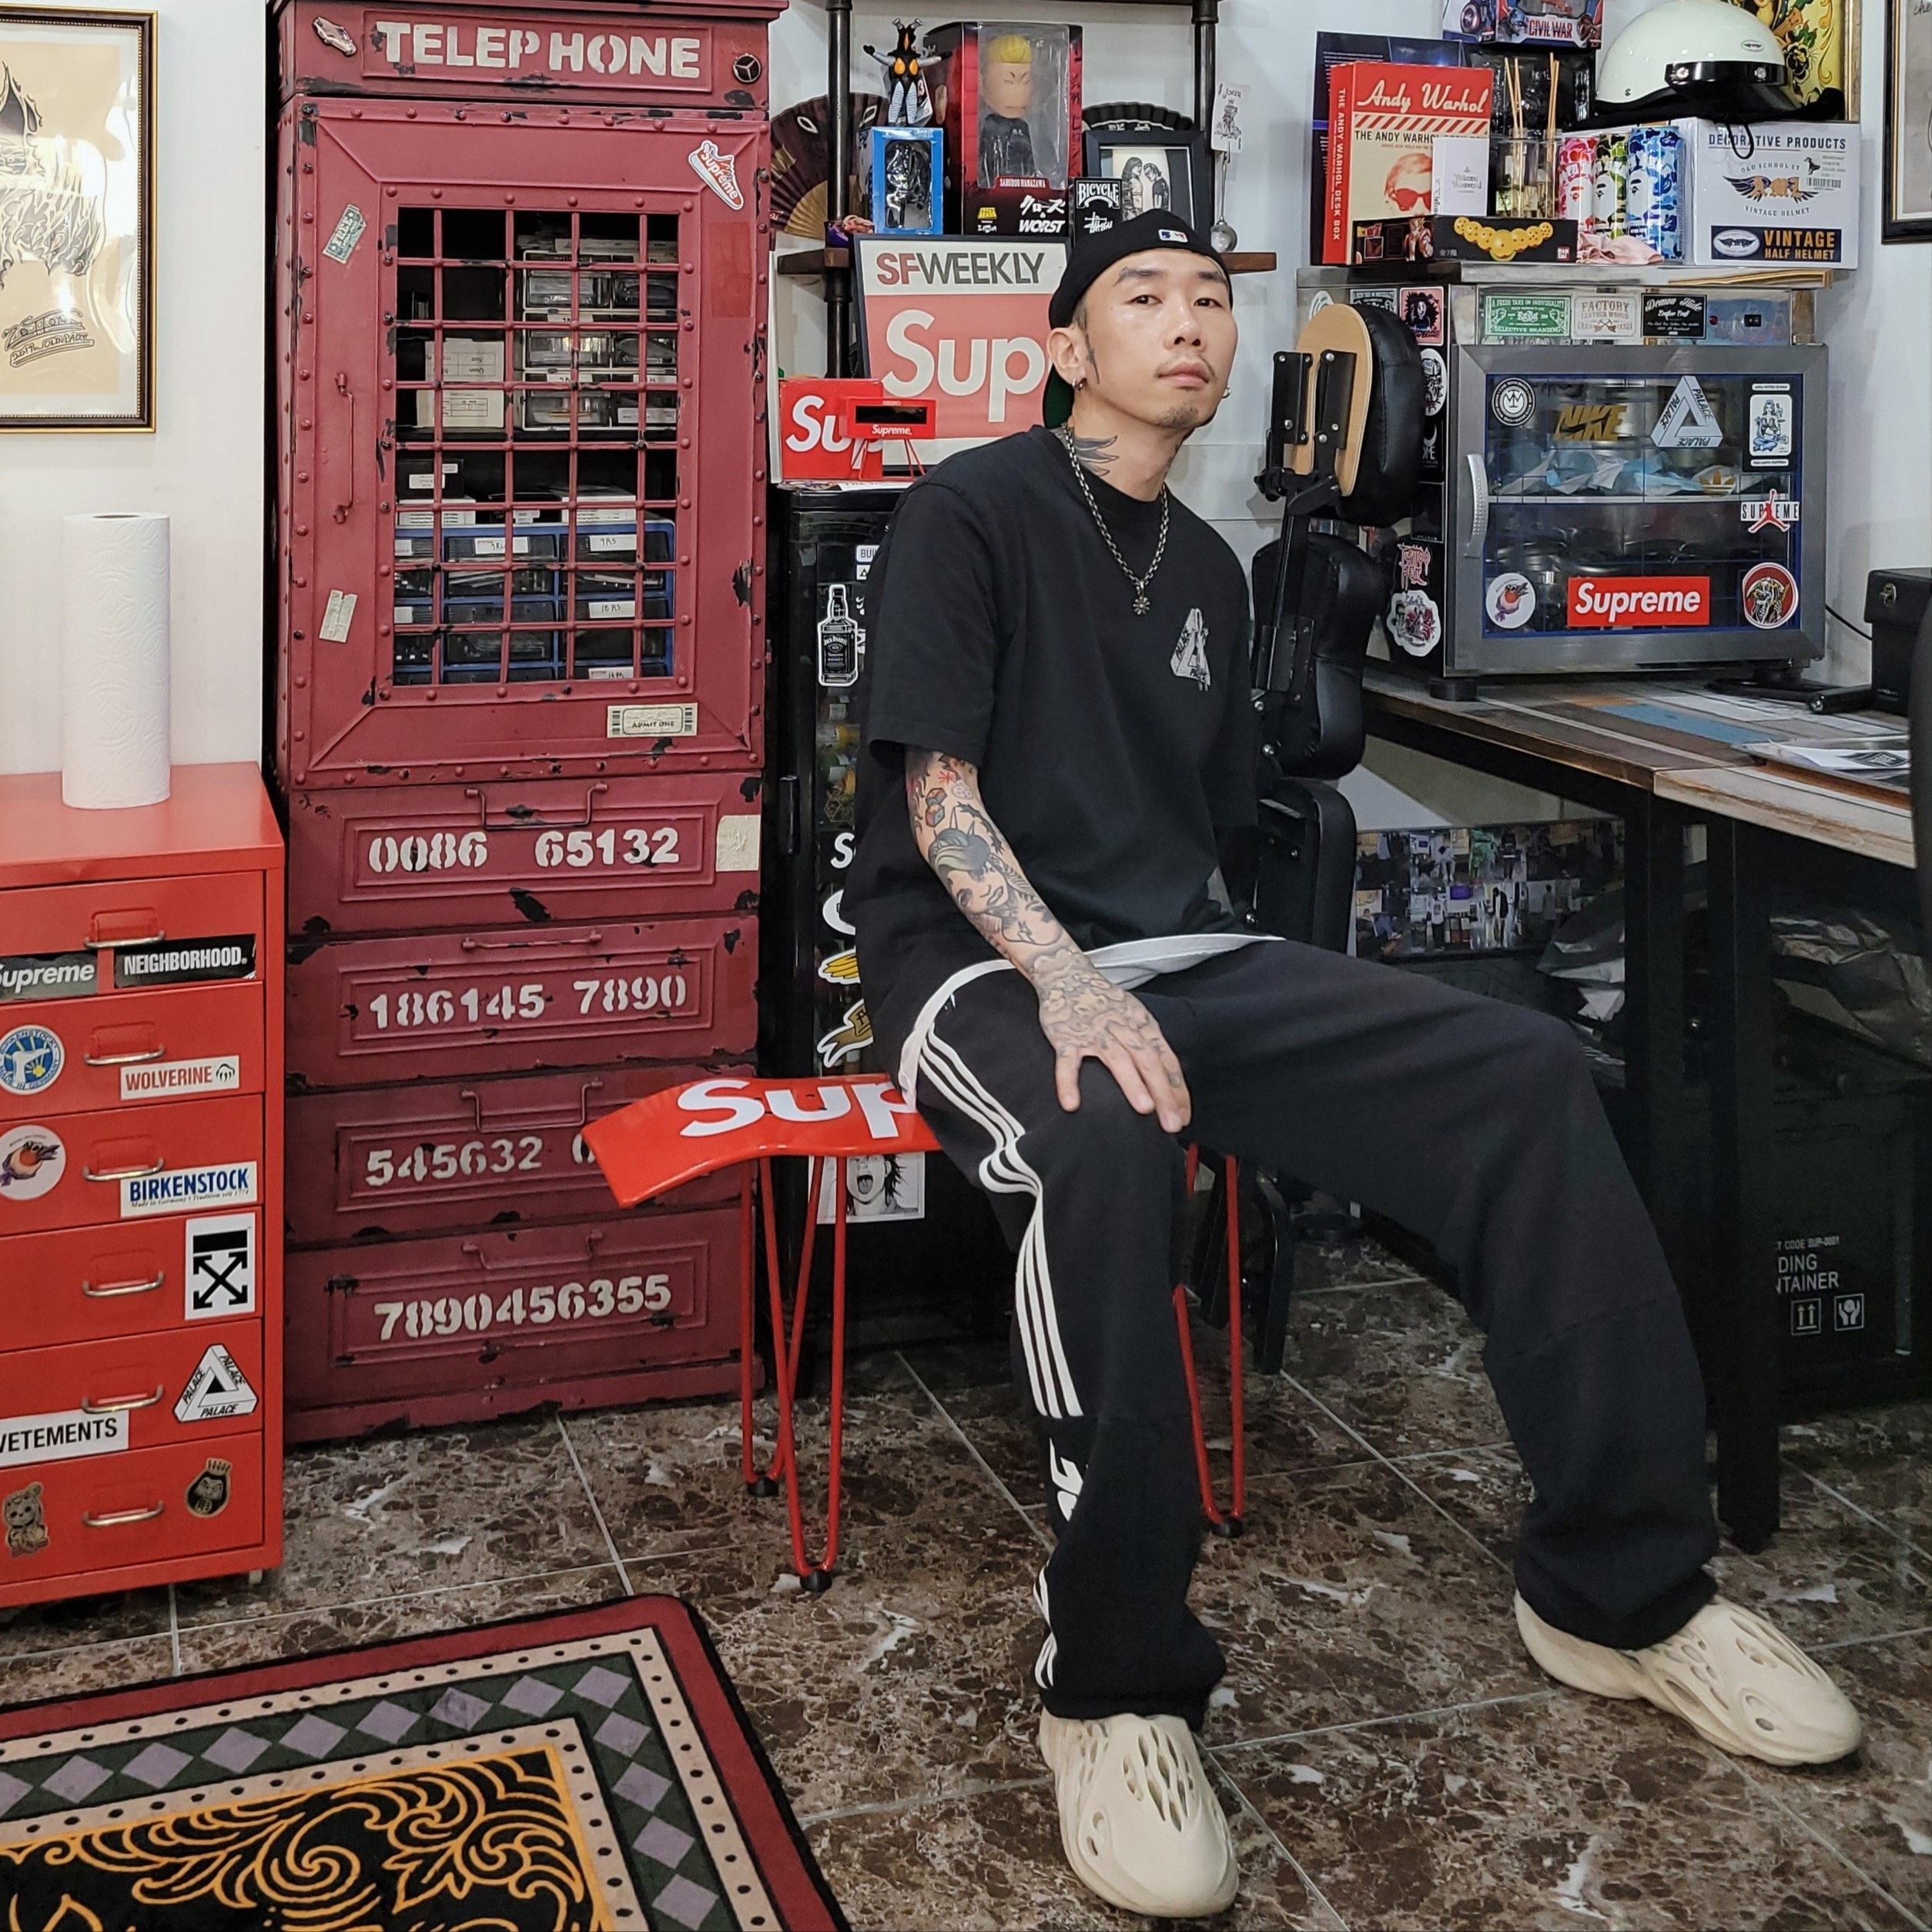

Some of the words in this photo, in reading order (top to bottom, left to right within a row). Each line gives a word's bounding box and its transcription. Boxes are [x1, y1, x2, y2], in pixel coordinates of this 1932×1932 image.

[1529, 19, 1551, 36] CIVIL
[1552, 22, 1573, 39] WAR
[376, 22, 699, 78] TELEPHONE
[1338, 88, 1346, 109] THE
[1357, 79, 1411, 113] Andy
[1421, 82, 1489, 113] Warhol
[1337, 112, 1345, 140] ANDY
[1354, 130, 1371, 141] THE
[1375, 132, 1400, 142] ANDY
[1403, 133, 1438, 144] WARHO
[1786, 137, 1847, 149] PRODUCTS
[699, 152, 738, 199] Supreme
[1334, 142, 1344, 187] WARHOL
[1078, 182, 1120, 208] BICYCLE
[1334, 189, 1342, 216] DESK
[1746, 206, 1777, 216] VINTAGE
[1780, 207, 1810, 216] HELMET
[1019, 219, 1066, 233] WORST
[1333, 219, 1341, 240] BOX
[1763, 229, 1836, 248] VINTAGE
[1764, 248, 1790, 259] HALF
[1794, 249, 1836, 260] HELMET
[1582, 300, 1629, 312] FACTORY
[1659, 393, 1680, 430] PALACE
[1692, 389, 1713, 420] PALACE
[872, 424, 912, 437] Supreme
[1553, 404, 1627, 441] NIKE
[1676, 437, 1711, 447] PALACE
[1742, 504, 1799, 519] SUPEME
[1575, 582, 1701, 622] Supreme
[369, 831, 488, 873] 0086
[535, 827, 680, 869] 65132
[370, 983, 545, 1029] 186145
[573, 976, 687, 1015] 7890
[126, 1066, 213, 1091] WOLVERINE
[365, 1136, 543, 1187] 545632
[129, 1167, 249, 1202] BIRKENSTOCK
[158, 1197, 186, 1206] Germany
[193, 1193, 220, 1201] Tradition
[1784, 1240, 1806, 1250] CODE
[1778, 1254, 1817, 1274] DING
[374, 1273, 671, 1341] 7890456355
[219, 1355, 246, 1386] PALACE
[182, 1368, 205, 1405] PALACE
[200, 1404, 239, 1418] PALACE
